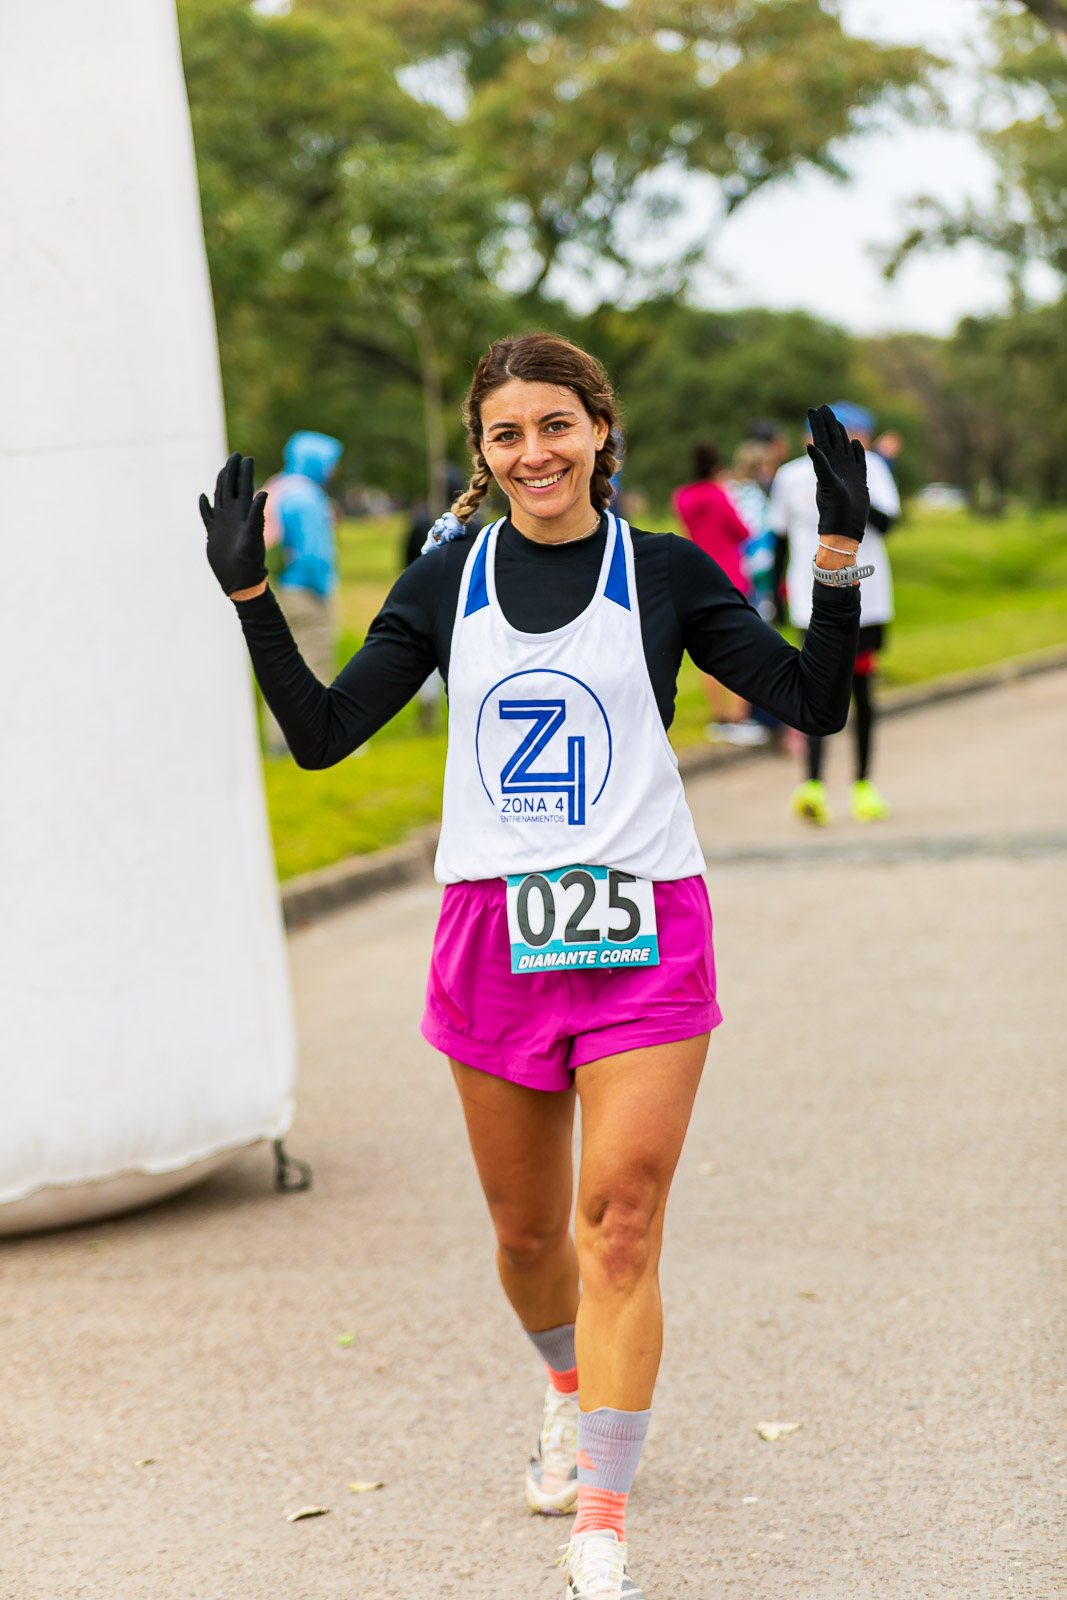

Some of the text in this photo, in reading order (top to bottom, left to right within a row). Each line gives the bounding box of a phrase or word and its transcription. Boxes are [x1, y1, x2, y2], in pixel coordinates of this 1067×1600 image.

[501, 797, 564, 813] ZONA 4
[500, 814, 565, 824] ENTRENAMIENTOS
[516, 869, 641, 947] 025
[518, 947, 651, 969] DIAMANTE CORRE
